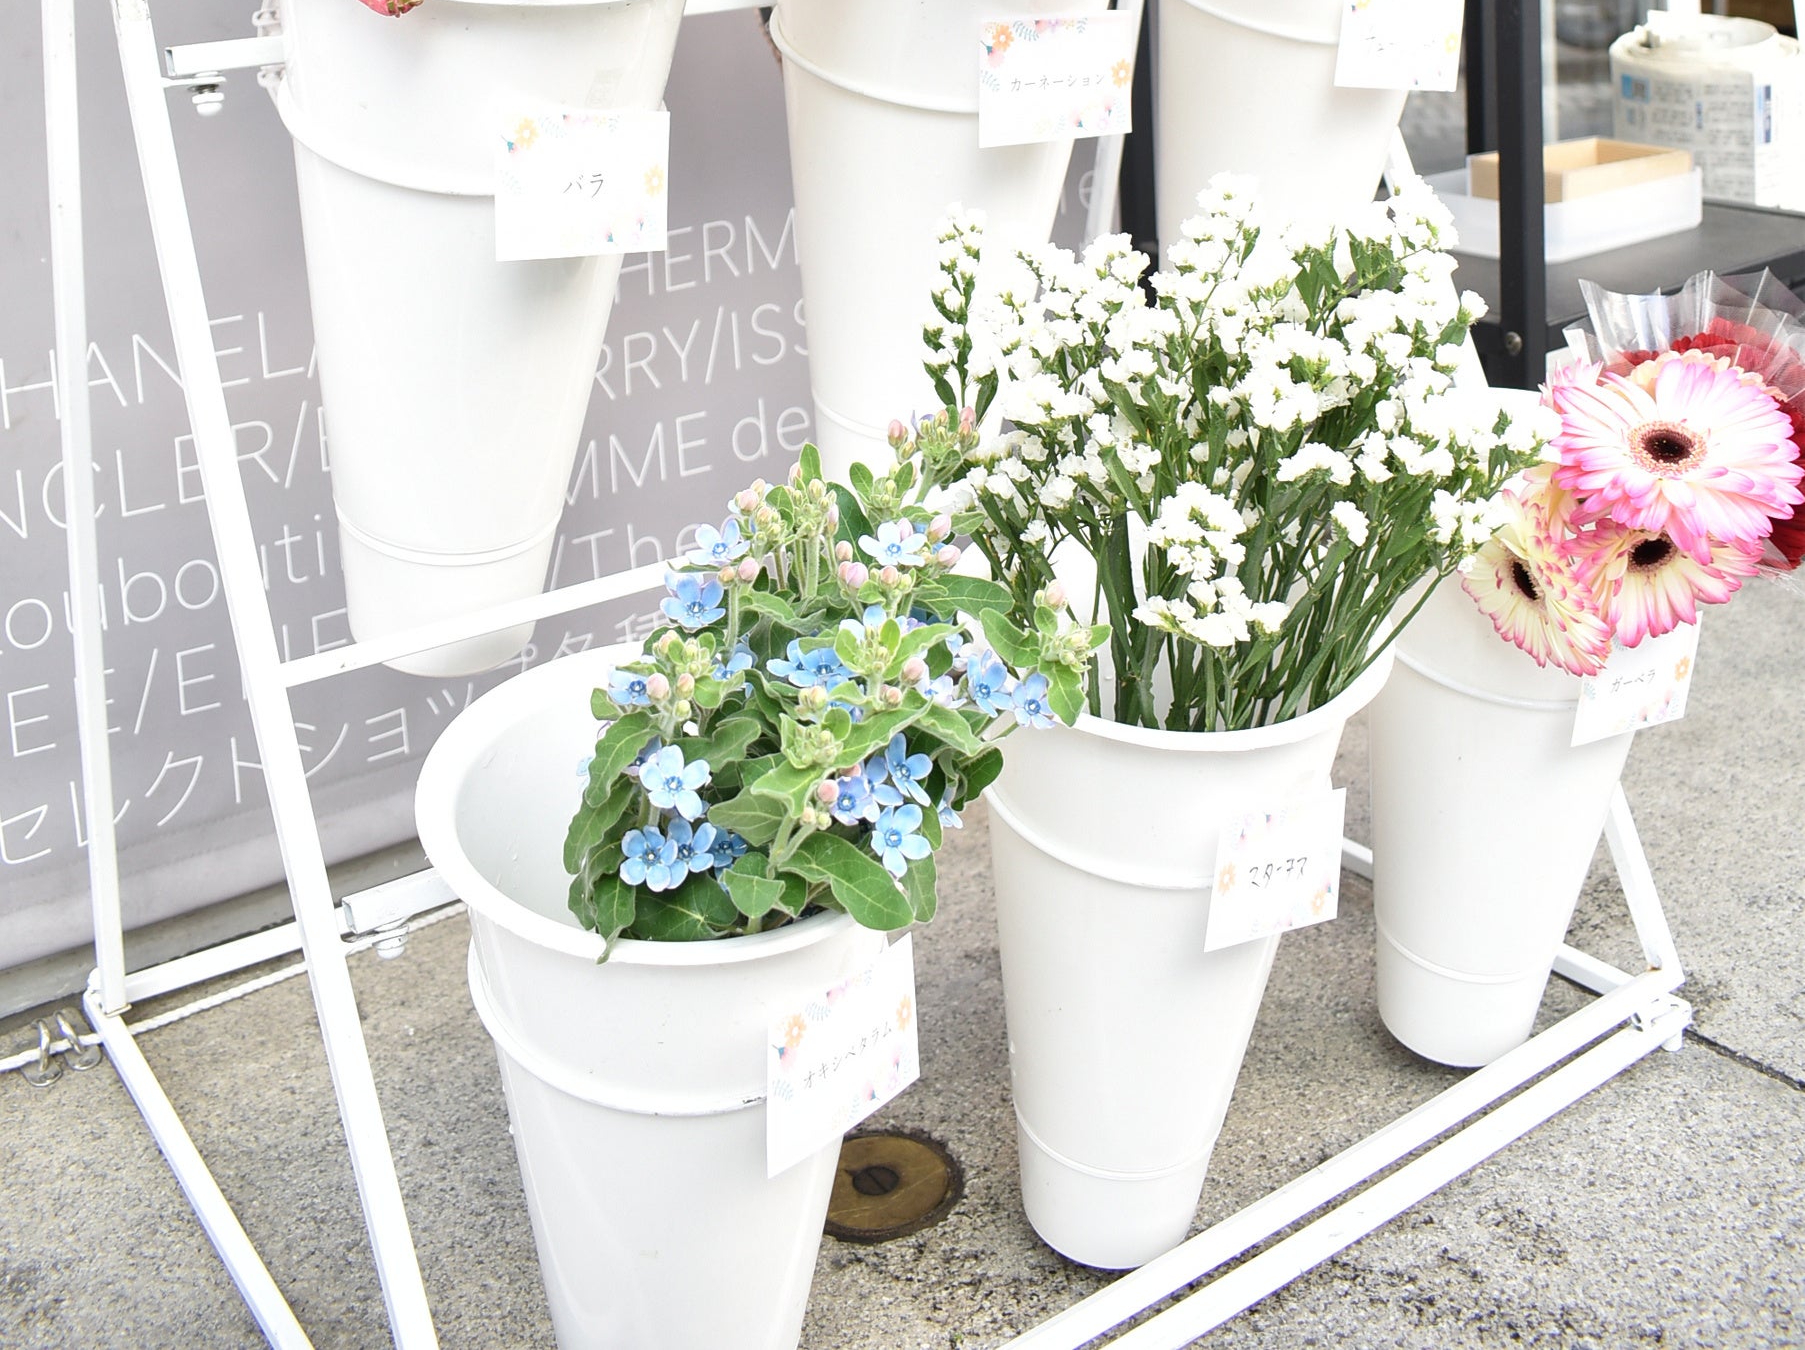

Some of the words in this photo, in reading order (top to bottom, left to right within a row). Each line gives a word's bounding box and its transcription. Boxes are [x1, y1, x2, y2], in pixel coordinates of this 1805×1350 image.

[1010, 74, 1105, 92] カーネーション
[563, 173, 605, 198] バラ
